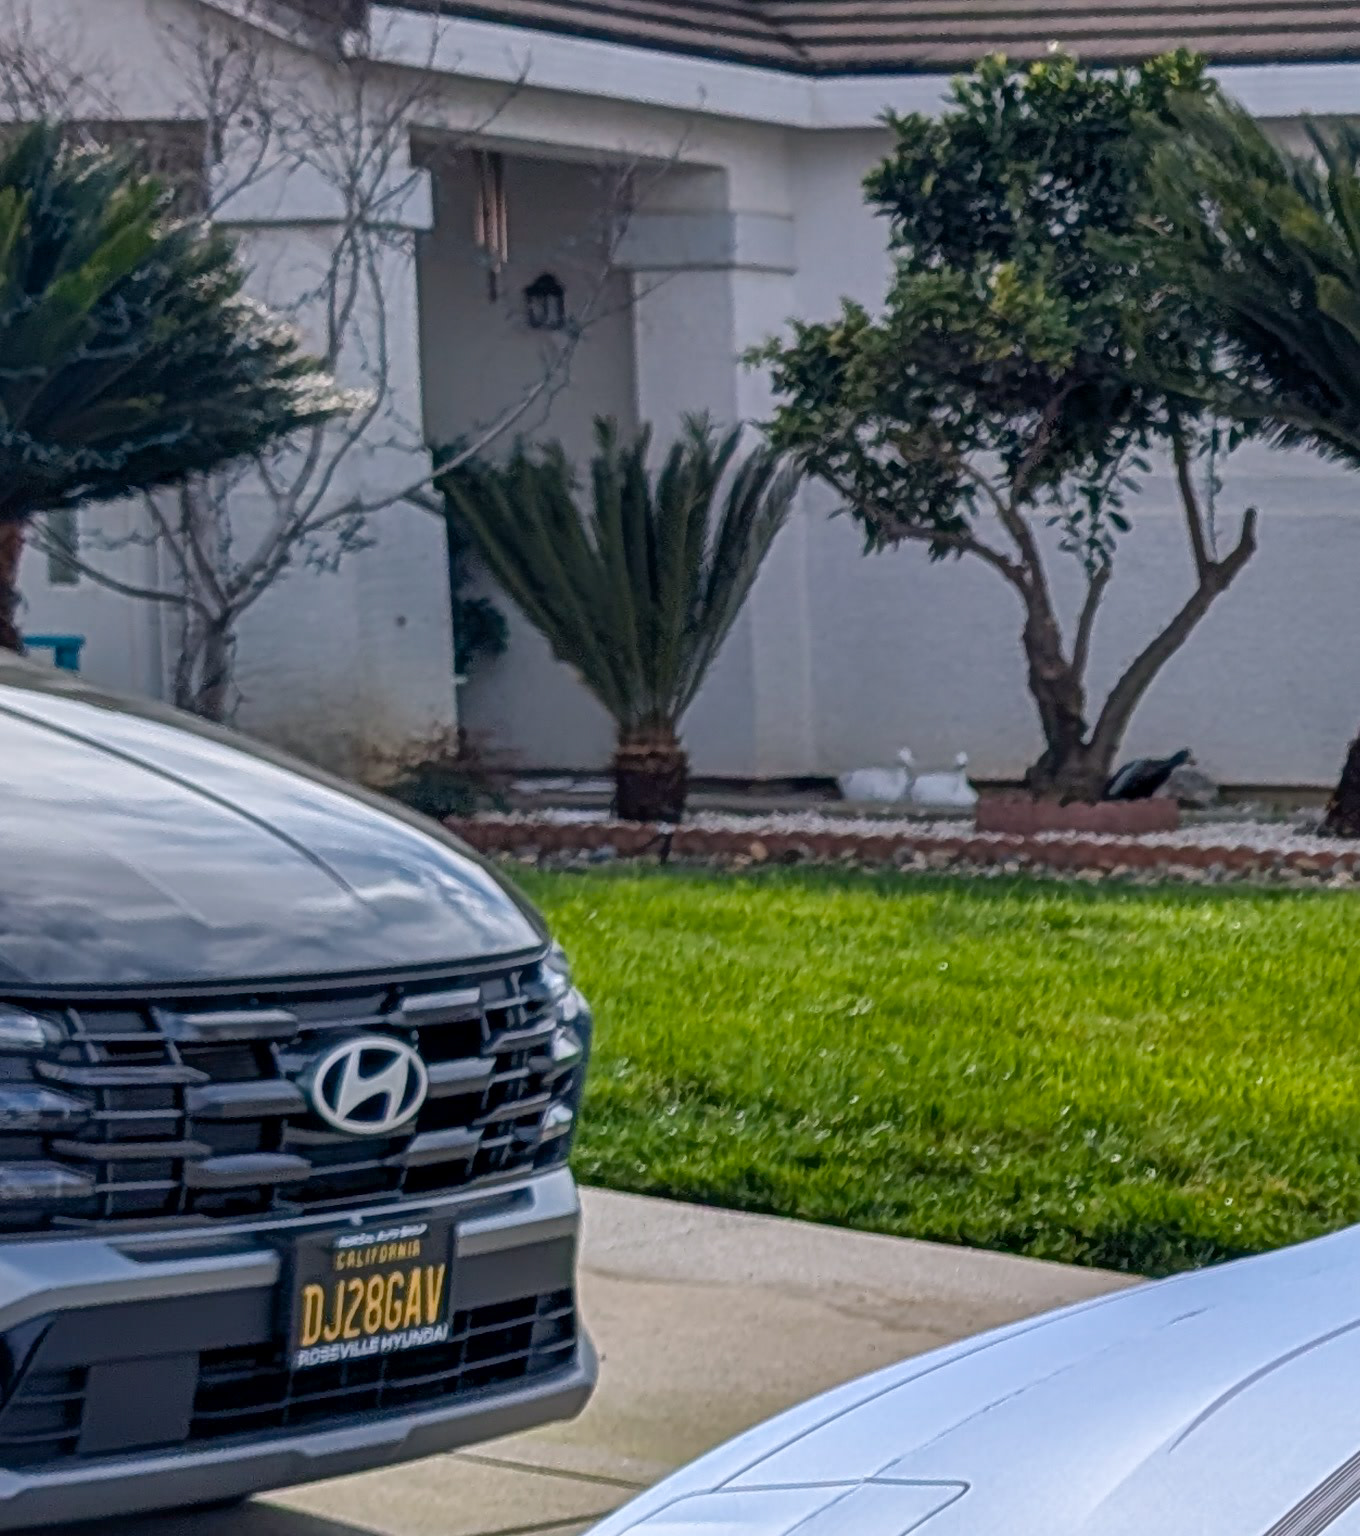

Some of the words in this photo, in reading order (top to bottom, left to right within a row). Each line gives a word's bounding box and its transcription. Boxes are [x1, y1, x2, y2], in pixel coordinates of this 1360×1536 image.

[335, 1239, 420, 1270] CALIFORNIA
[300, 1263, 445, 1347] DJ28GAV
[298, 1336, 380, 1366] ROSEVILLE
[381, 1323, 448, 1350] HYUNDAI
